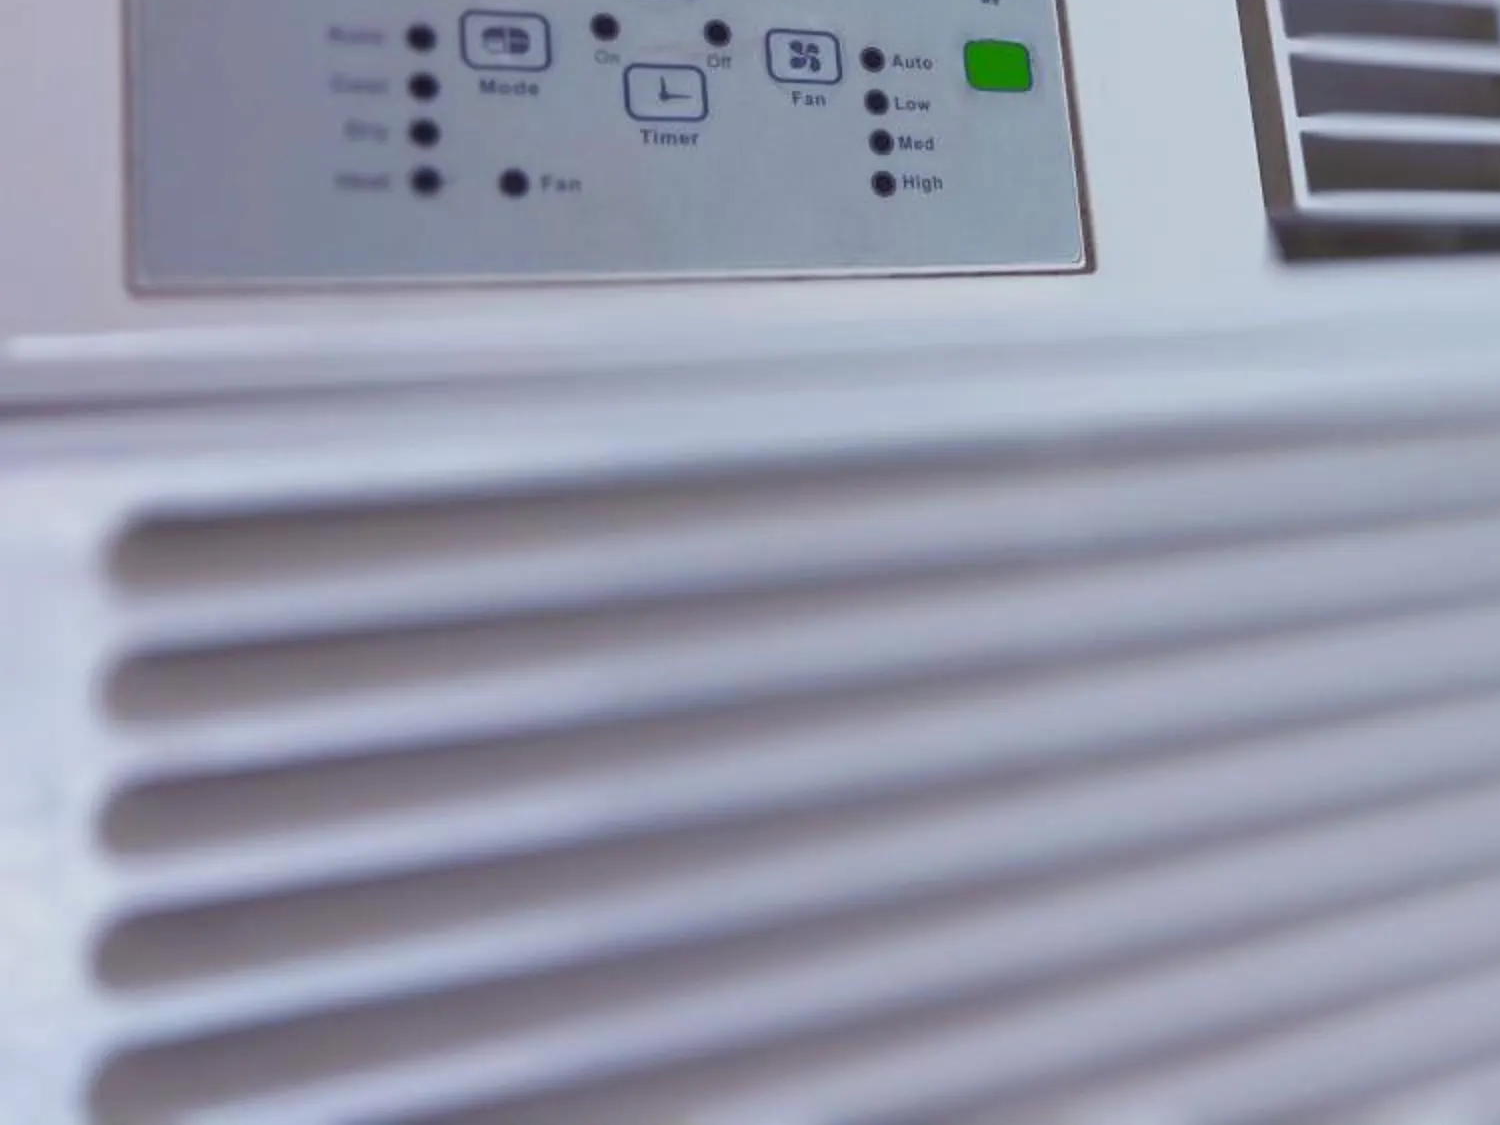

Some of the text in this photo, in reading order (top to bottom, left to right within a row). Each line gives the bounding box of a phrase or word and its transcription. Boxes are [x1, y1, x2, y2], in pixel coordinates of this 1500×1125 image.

[595, 51, 620, 65] On
[706, 53, 732, 69] Off
[892, 55, 934, 70] Auto
[479, 78, 540, 97] Mode
[792, 91, 827, 107] Fan
[894, 97, 931, 113] Low
[640, 129, 699, 147] Timer
[898, 136, 935, 152] Med
[540, 175, 582, 193] Fan
[902, 174, 944, 193] High
